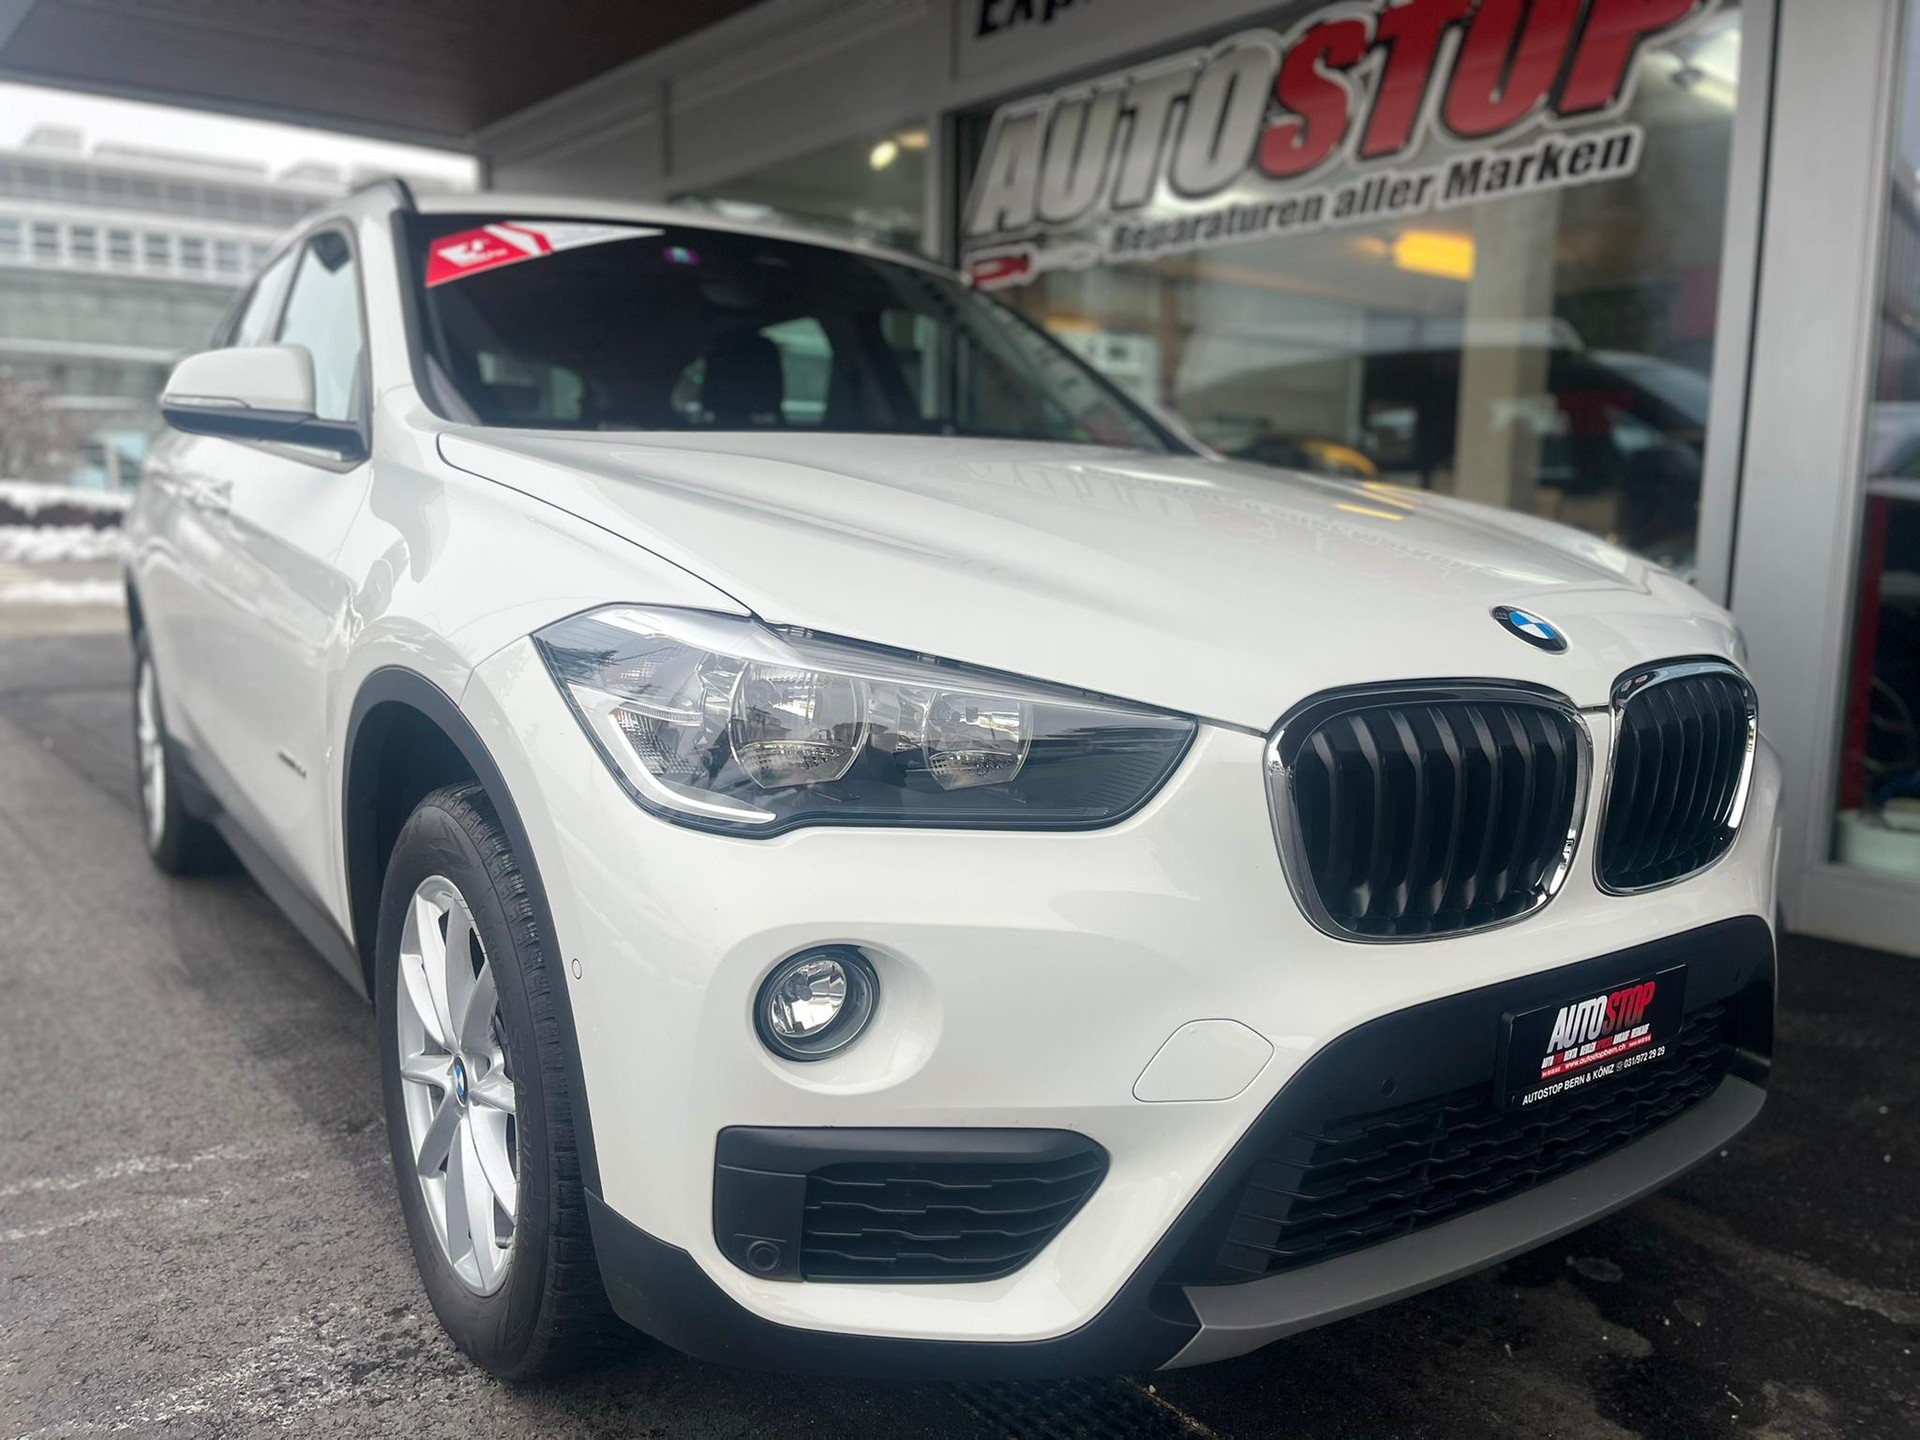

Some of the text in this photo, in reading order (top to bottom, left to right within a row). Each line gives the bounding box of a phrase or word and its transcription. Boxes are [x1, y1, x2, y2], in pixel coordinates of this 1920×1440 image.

[968, 0, 1697, 228] AUTOSTOP
[1112, 134, 1633, 252] Reparaturen aller Marken
[1547, 982, 1655, 1053] AUTOSTOP
[1522, 1082, 1564, 1106] AUTOSTOP
[1564, 1074, 1585, 1091] BERN
[1585, 1072, 1592, 1083] &
[1648, 1048, 1657, 1060] 29
[1657, 1045, 1666, 1057] 29
